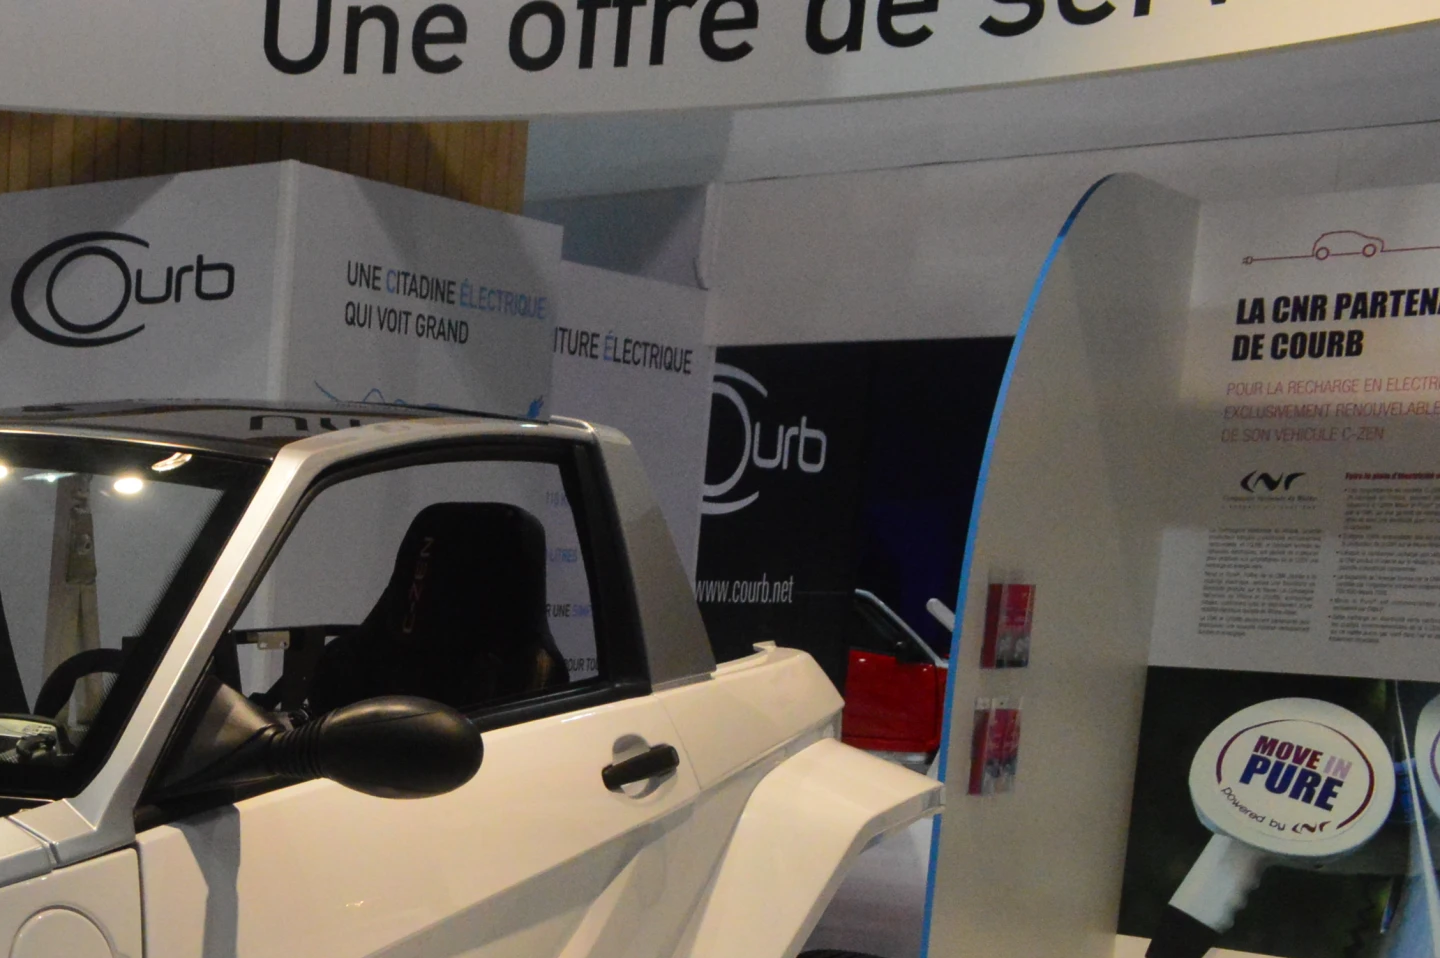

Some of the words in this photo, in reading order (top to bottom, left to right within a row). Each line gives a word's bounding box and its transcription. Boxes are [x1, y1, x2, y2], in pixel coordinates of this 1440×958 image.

[263, 0, 468, 75] Une
[508, 0, 760, 72] offre
[11, 231, 235, 348] Courb
[347, 260, 382, 291] UNE
[386, 269, 456, 305] CITADINE
[460, 278, 547, 319] ÉLECTRIQUE
[1236, 298, 1265, 325] LA
[1272, 294, 1328, 324] CNR
[345, 301, 372, 329] QUI
[378, 307, 412, 335] VOIT
[415, 316, 469, 344] GRAND
[603, 330, 693, 375] ÉLECTRIQUE
[1232, 334, 1265, 361] DE
[1270, 329, 1364, 360] COURB
[1227, 381, 1262, 396] POUR
[1267, 381, 1283, 395] LA
[1288, 378, 1359, 394] RECHARGE
[1364, 378, 1382, 392] EN
[1224, 403, 1331, 420] EXCLUSIVEMENT
[1221, 428, 1239, 443] DE
[1243, 428, 1270, 442] SON
[1342, 426, 1384, 440] C-ZEN
[695, 572, 794, 605] www.courb.net
[1252, 735, 1323, 770] MOVE
[1323, 755, 1353, 780] IN
[1239, 754, 1344, 811] PURE
[1221, 786, 1267, 823] powered
[1269, 817, 1286, 831] by
